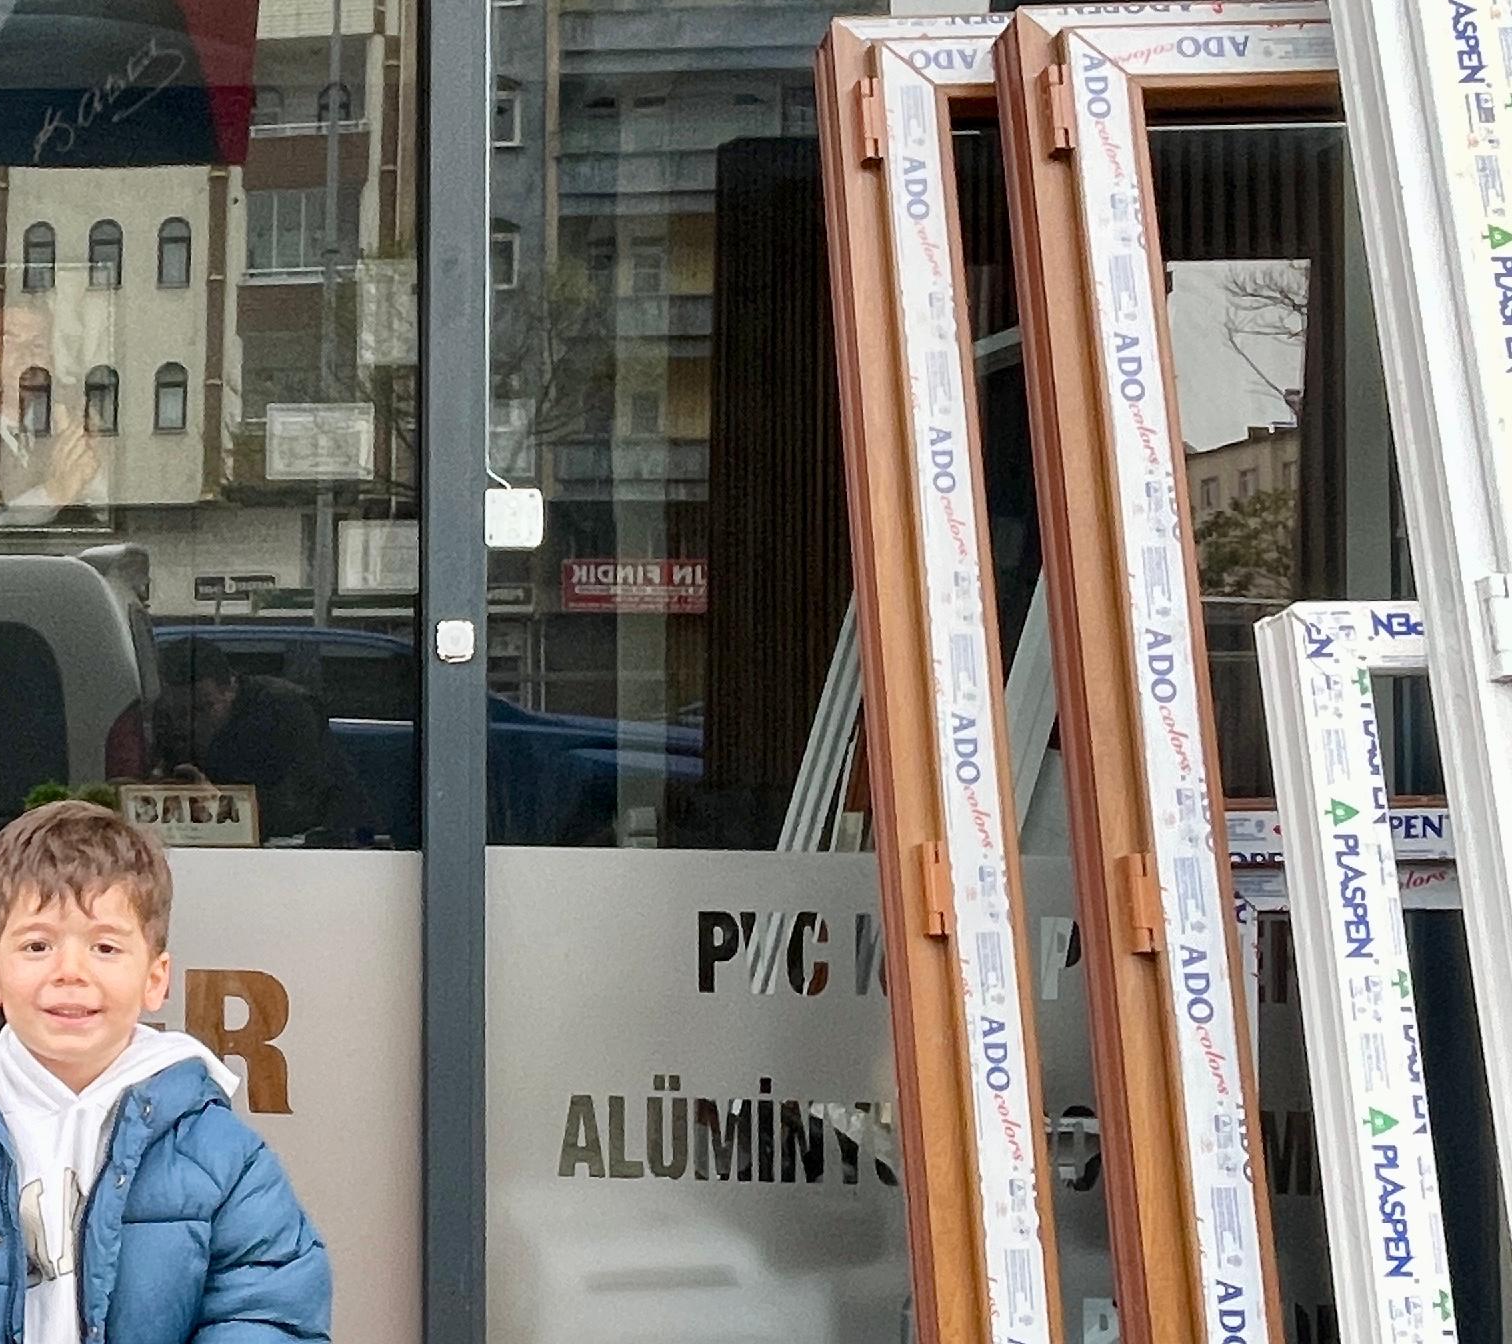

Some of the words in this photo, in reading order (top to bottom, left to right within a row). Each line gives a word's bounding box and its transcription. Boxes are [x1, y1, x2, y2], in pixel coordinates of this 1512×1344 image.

[697, 910, 830, 997] PVC
[1333, 833, 1374, 958] PLASPEN
[1371, 1144, 1415, 1278] PLASPEN
